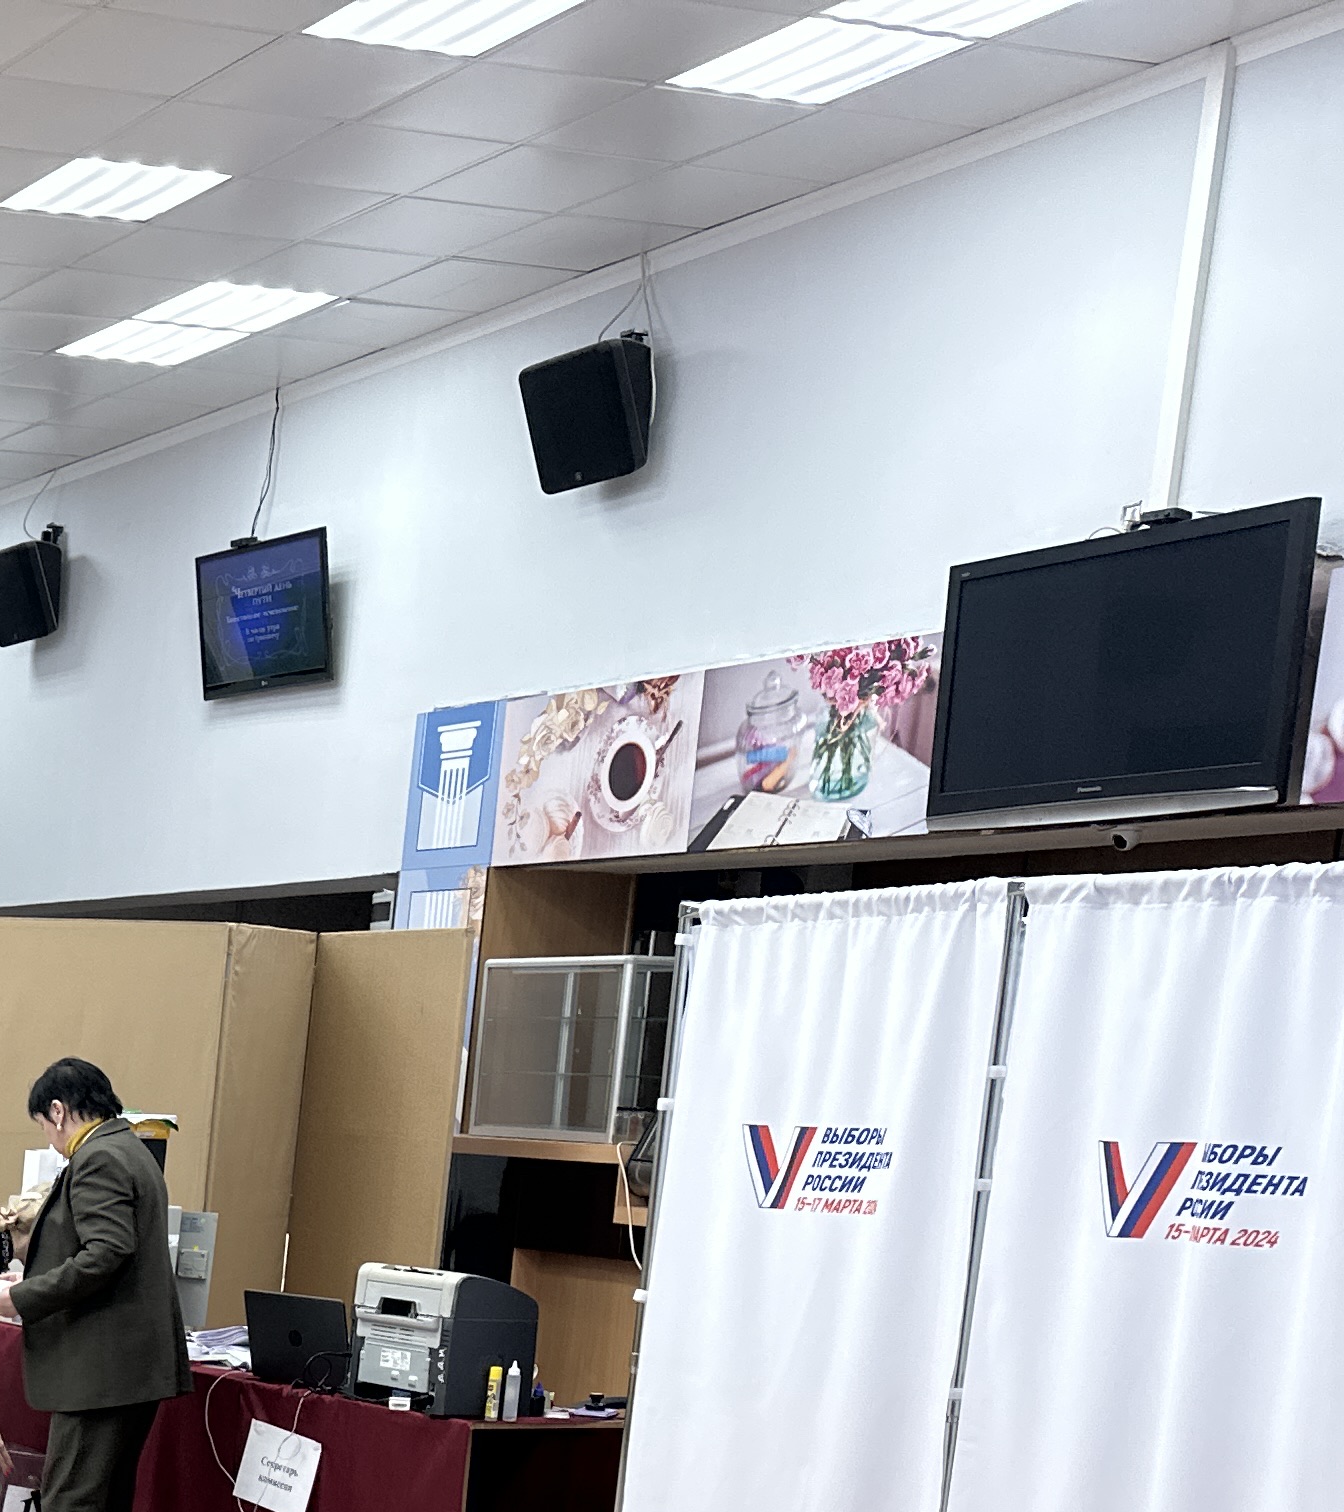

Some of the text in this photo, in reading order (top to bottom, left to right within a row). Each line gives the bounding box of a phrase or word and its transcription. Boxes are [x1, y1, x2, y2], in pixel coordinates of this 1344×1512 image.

[821, 1127, 887, 1146] ВЫБОРЫ
[802, 1174, 867, 1193] РОССИИ
[821, 1197, 863, 1215] МАРТА
[1229, 1229, 1281, 1249] 2024
[261, 1456, 299, 1478] Секретарь
